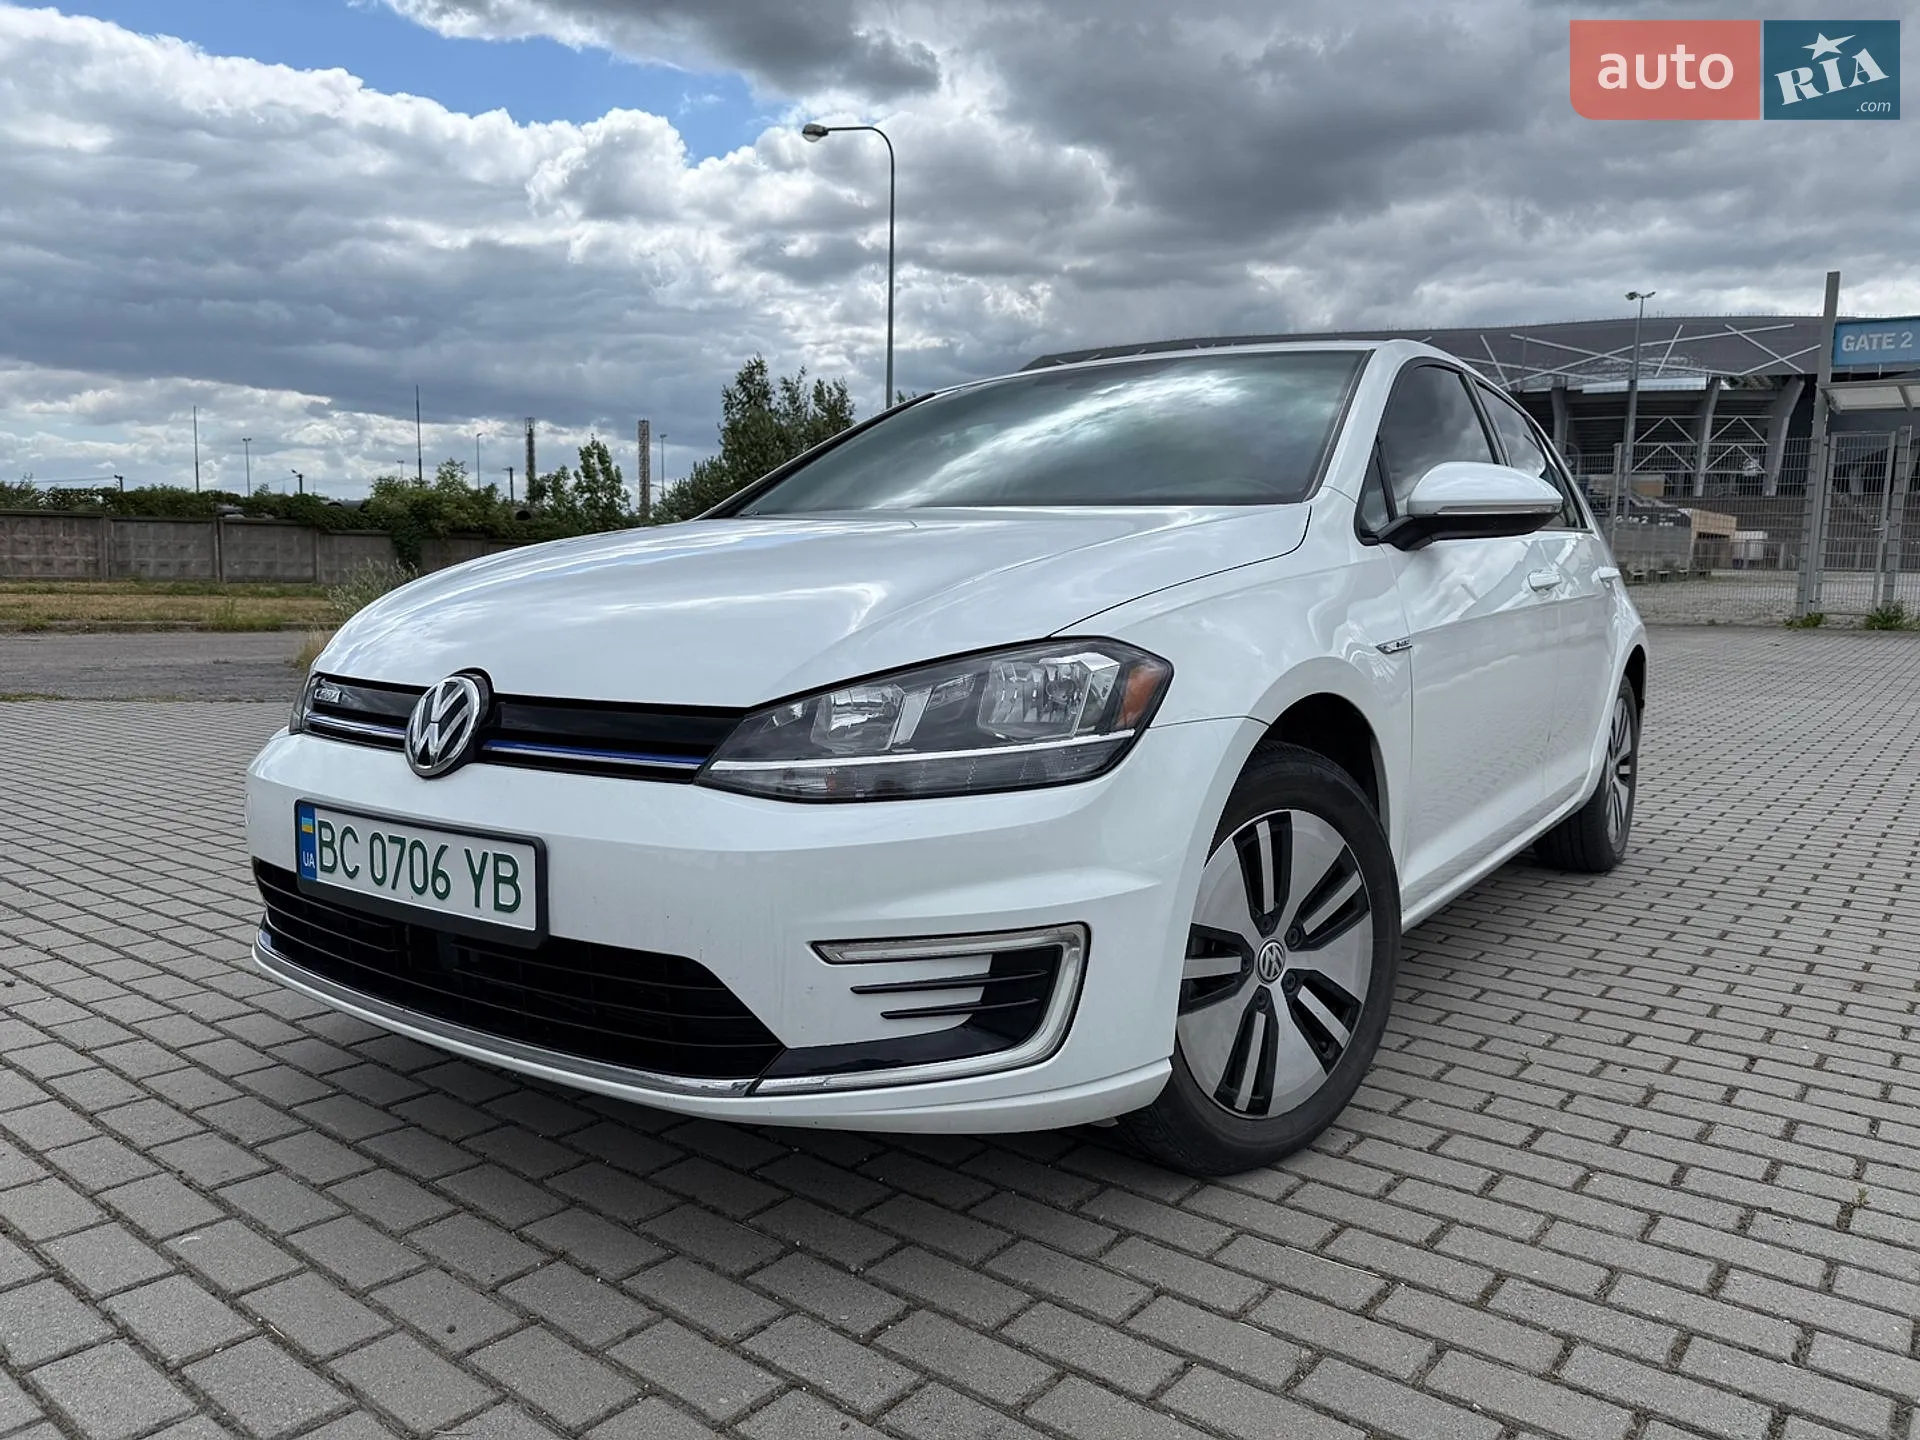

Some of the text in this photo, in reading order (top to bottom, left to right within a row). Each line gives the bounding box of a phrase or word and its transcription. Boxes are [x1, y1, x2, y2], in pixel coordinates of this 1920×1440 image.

[1842, 331, 1913, 352] GATE 2
[302, 850, 316, 869] UA
[318, 820, 521, 913] BC 0706 YB
